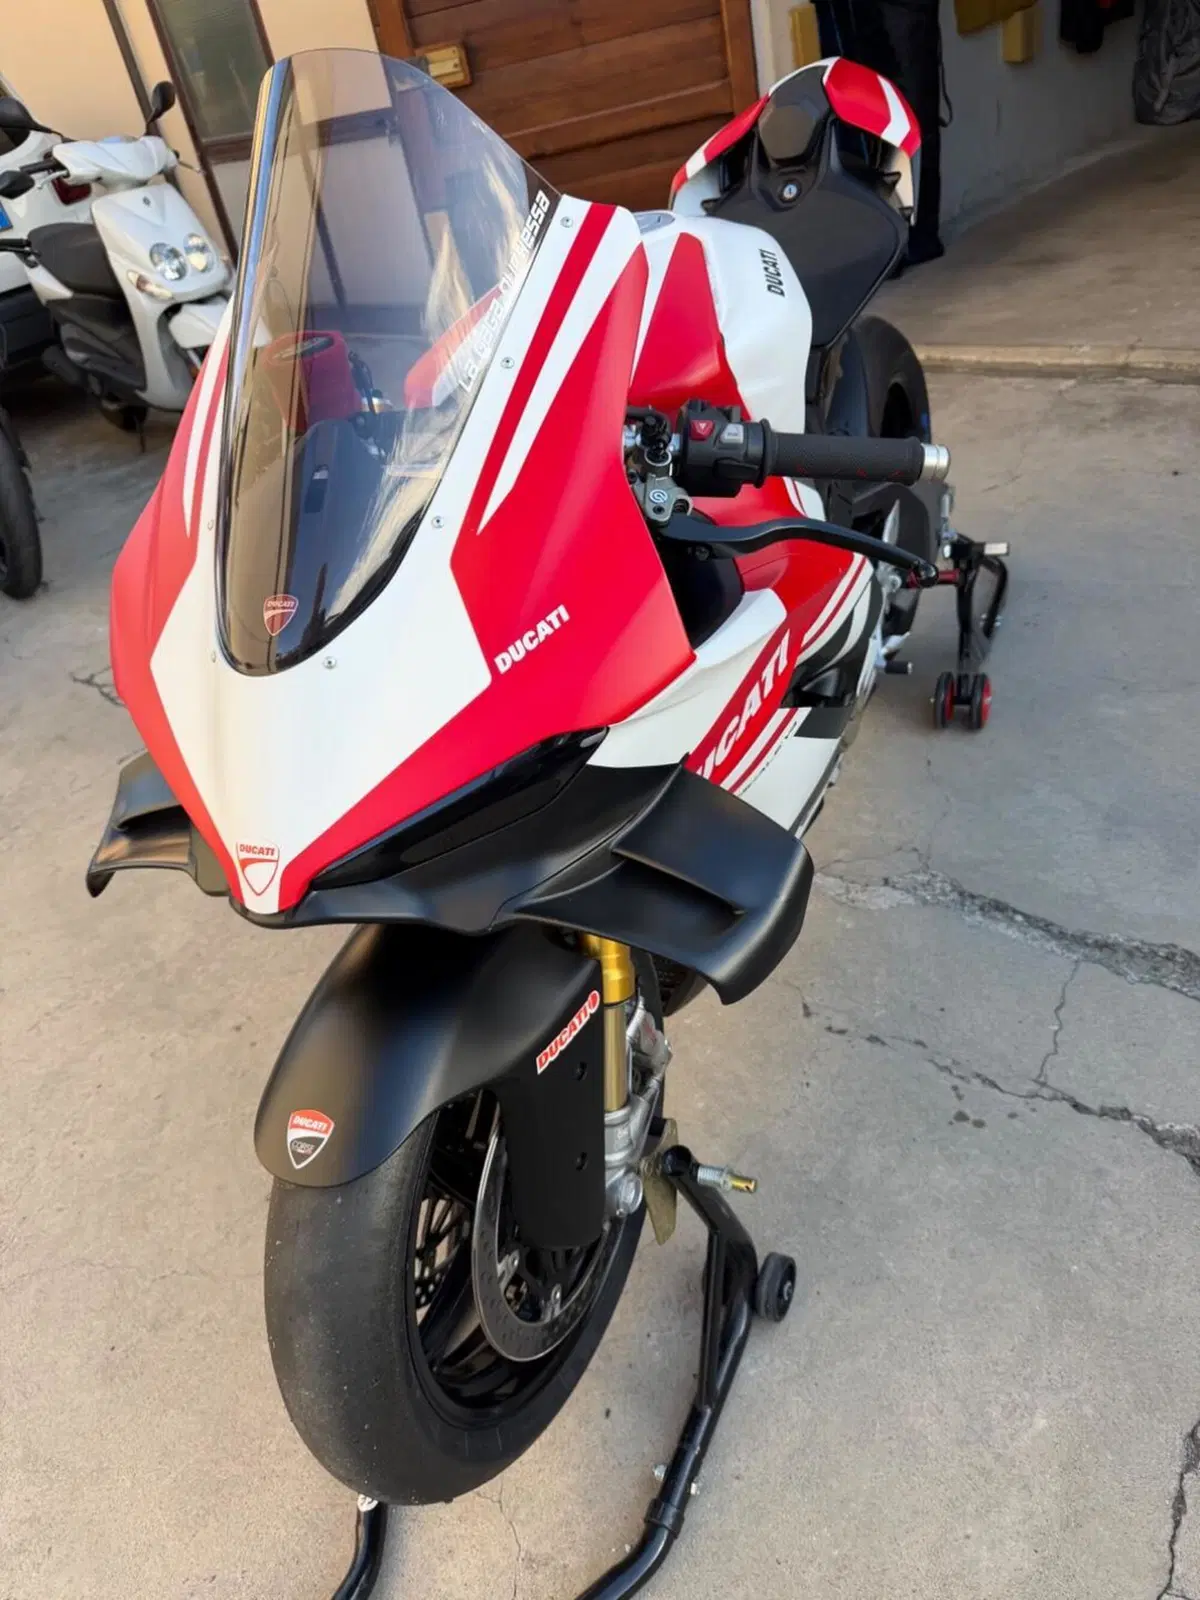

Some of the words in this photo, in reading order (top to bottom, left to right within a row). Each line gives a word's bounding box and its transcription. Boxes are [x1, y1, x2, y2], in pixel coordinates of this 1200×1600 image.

[759, 248, 785, 298] DUCATI
[493, 603, 570, 675] DUCATI
[239, 843, 275, 856] DUCATI
[537, 1002, 590, 1071] DUCATI
[293, 1115, 328, 1131] DUCATI
